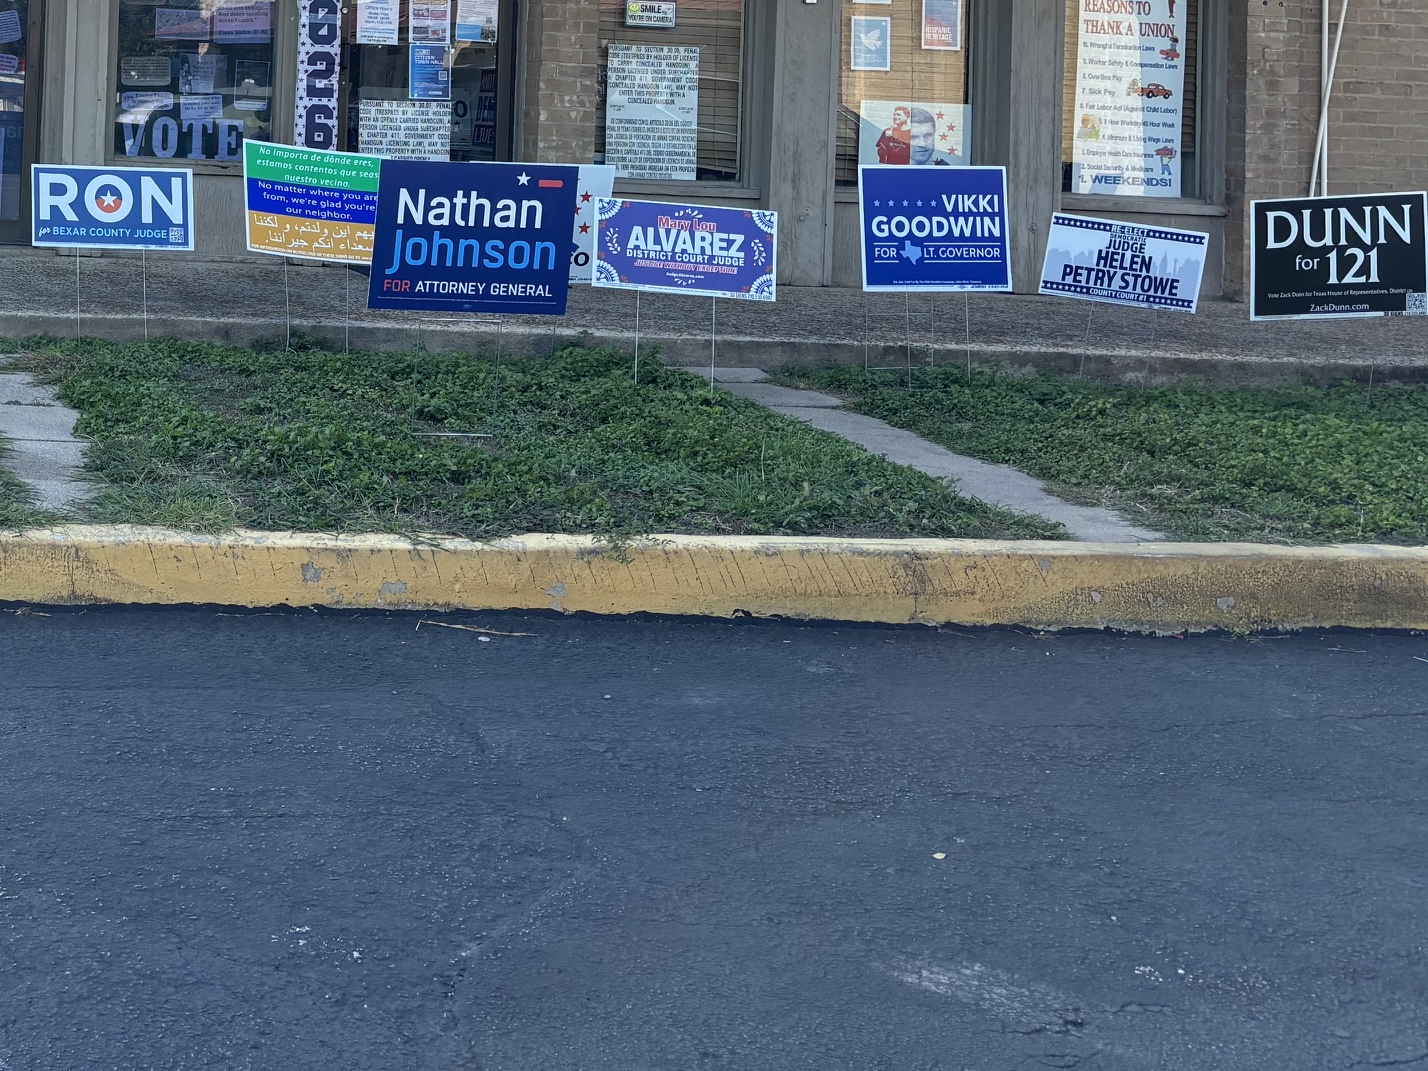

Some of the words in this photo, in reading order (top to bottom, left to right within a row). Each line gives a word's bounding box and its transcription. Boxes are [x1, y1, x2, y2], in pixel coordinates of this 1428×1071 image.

[641, 5, 662, 14] SMILE
[1136, 1, 1151, 16] TO
[925, 26, 952, 34] HISPANIC
[925, 33, 953, 42] HERITAGE
[1084, 19, 1123, 36] THANK
[1125, 21, 1134, 36] A
[1139, 23, 1176, 39] UNION
[118, 115, 244, 161] VOTE
[259, 146, 271, 155] No
[273, 148, 308, 160] importa
[310, 152, 321, 161] de
[324, 154, 351, 165] dónde
[353, 158, 374, 168] eres,
[256, 158, 293, 169] estamos
[295, 164, 338, 175] contentos
[339, 169, 357, 178] que
[359, 171, 379, 179] seas
[284, 174, 318, 184] nuestro
[320, 178, 351, 188] vecino.
[1090, 175, 1172, 187] WEEKENDS!
[39, 172, 184, 224] RON
[258, 181, 272, 190] No
[274, 183, 307, 194] matter
[309, 188, 340, 198] where
[342, 192, 361, 201] you
[263, 191, 289, 203] from,
[291, 196, 318, 206] we're
[320, 200, 342, 210] glad
[344, 202, 376, 212] you're
[396, 187, 544, 229] Nathan
[941, 194, 999, 212] VIKKI
[285, 206, 303, 214] our
[305, 208, 353, 220] neighbor.
[39, 226, 52, 237] for
[52, 227, 86, 236] BEXAR
[89, 227, 131, 238] COUNTY
[133, 229, 168, 239] JUDGE
[657, 215, 690, 231] Mary
[692, 218, 717, 232] Lou
[871, 215, 1001, 238] GOODWIN
[1110, 224, 1149, 237] RE-ELECT
[1265, 204, 1413, 249] DUNN
[627, 225, 746, 258] ALVAREZ
[1105, 239, 1147, 254] JUDGE
[1109, 233, 1147, 244] DEMOCRATIC
[384, 229, 557, 275] Johnson
[626, 249, 672, 260] DISTRICT
[675, 253, 710, 264] COURT
[712, 256, 746, 267] JUDGE
[874, 247, 897, 258] FOR
[924, 247, 937, 258] LT.
[938, 247, 1000, 258] GOVERNOR
[1095, 249, 1153, 274] HELEN
[1295, 254, 1320, 271] for
[1325, 246, 1381, 285] 121
[383, 279, 411, 292] FOR
[415, 280, 488, 295] ATTORNEY
[490, 282, 553, 297] GENERAL
[1061, 264, 1118, 290] PETRY
[1118, 273, 1180, 297] STOWE
[1089, 287, 1117, 299] COUNTY
[1116, 291, 1139, 301] COURT
[1310, 302, 1370, 312] ZackDunn.com
